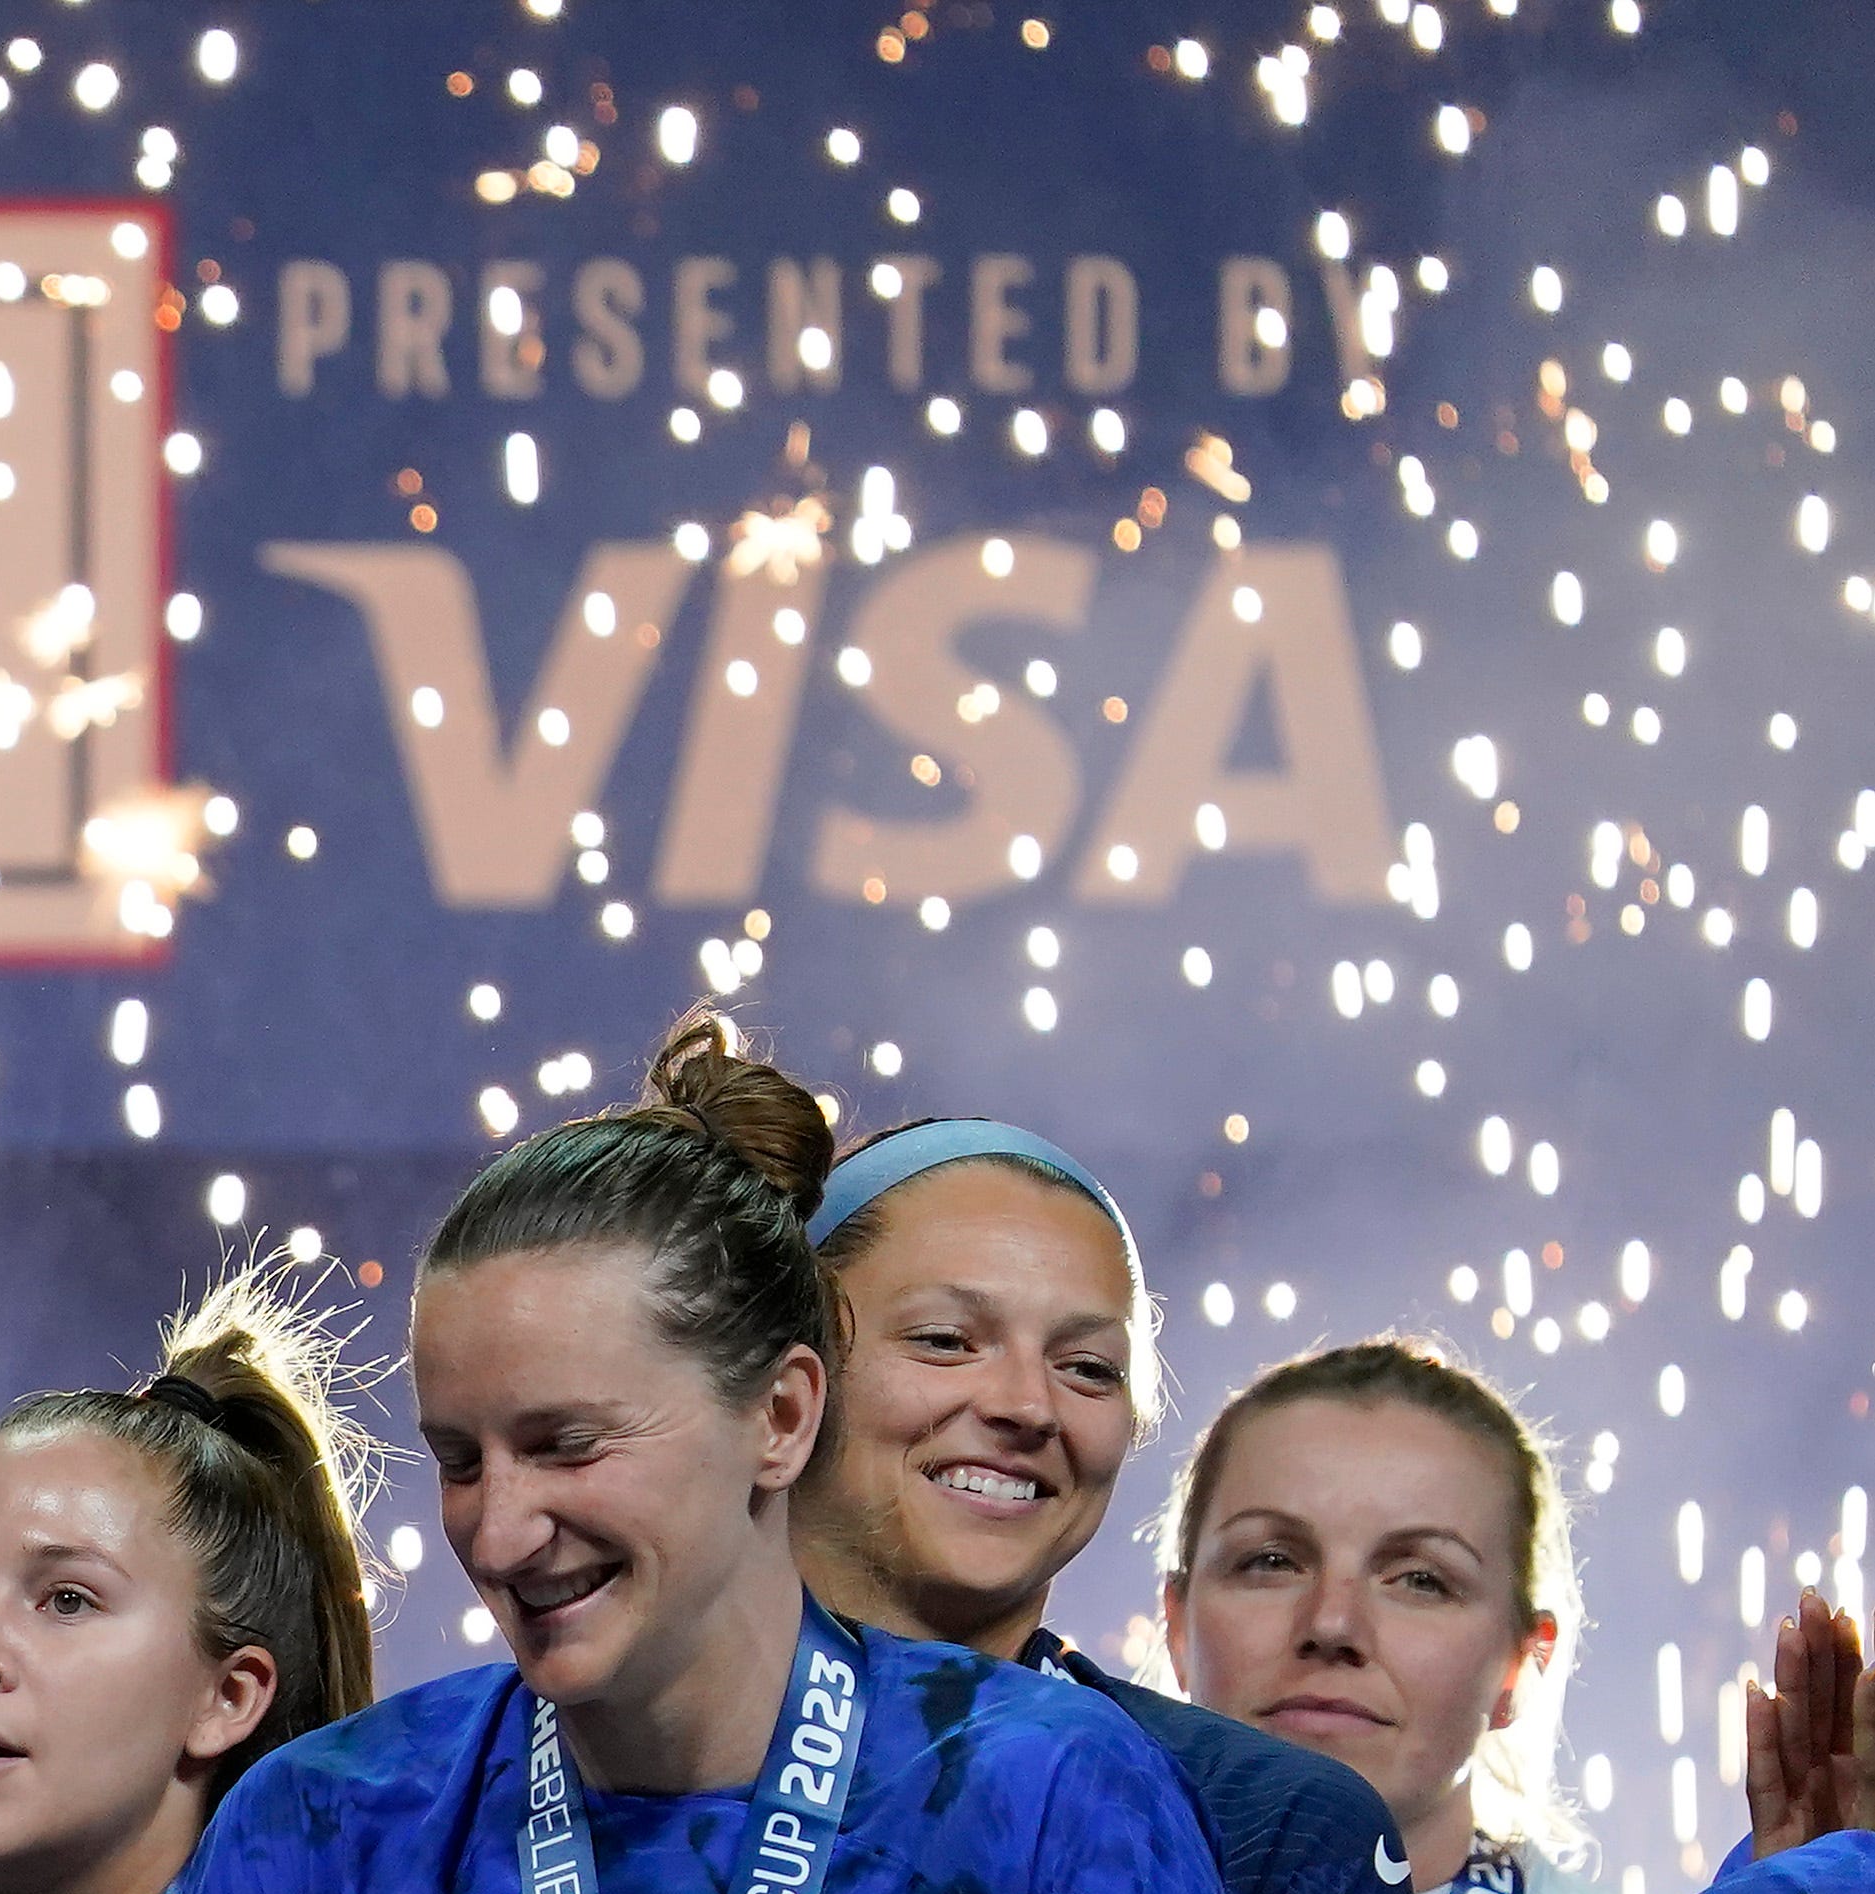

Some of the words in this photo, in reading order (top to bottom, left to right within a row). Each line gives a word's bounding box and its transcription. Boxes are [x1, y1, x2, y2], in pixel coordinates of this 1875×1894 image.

[276, 254, 1140, 398] PRESENTED
[1218, 256, 1408, 400] BY
[262, 538, 1404, 908] VISA
[781, 1656, 857, 1805] 2023
